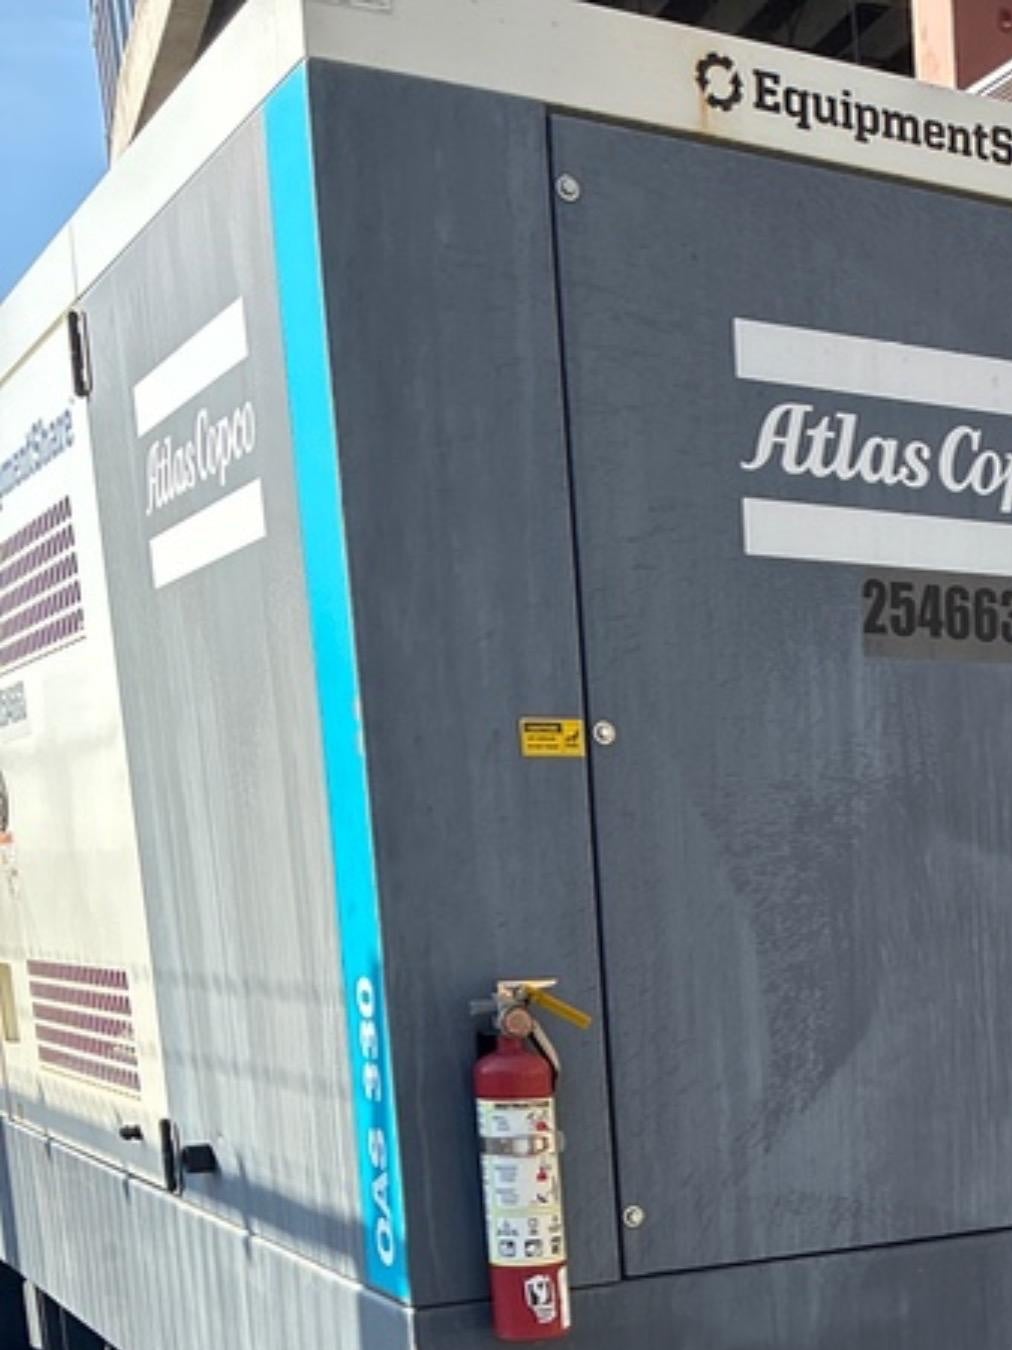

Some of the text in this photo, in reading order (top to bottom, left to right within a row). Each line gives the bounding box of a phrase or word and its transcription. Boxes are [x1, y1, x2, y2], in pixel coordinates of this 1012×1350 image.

[145, 400, 255, 516] Atlas Copco
[740, 402, 932, 488] Atlas
[355, 975, 382, 1103] 330
